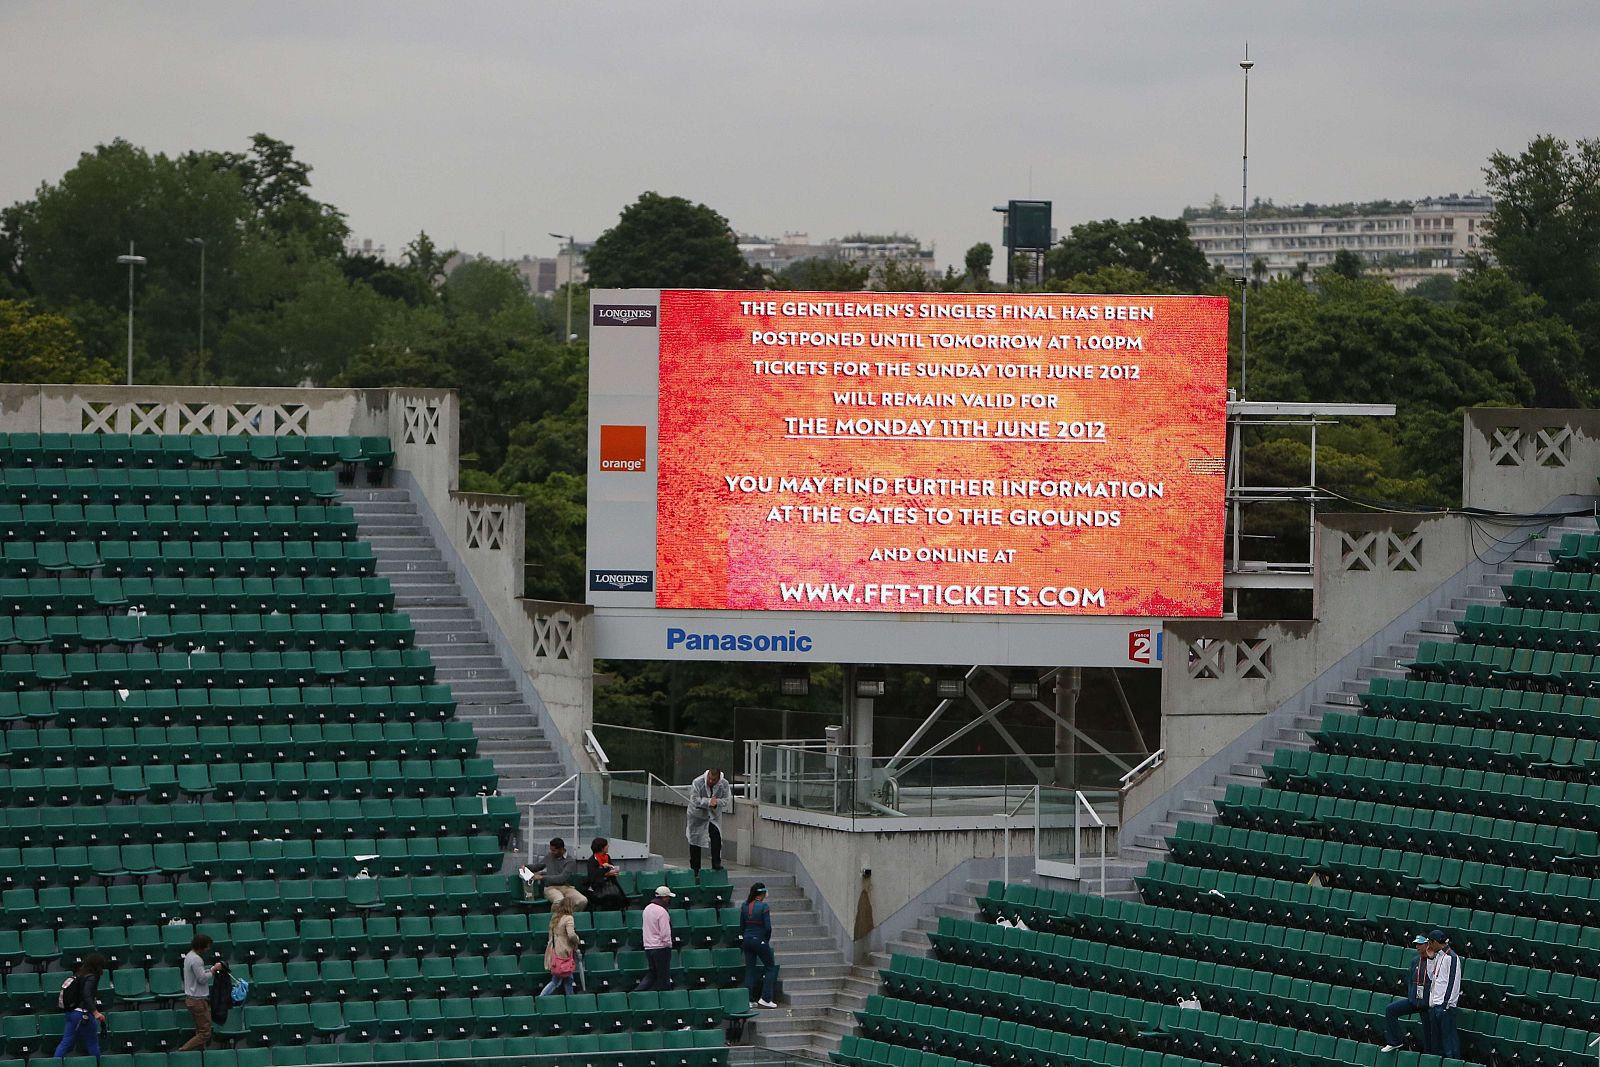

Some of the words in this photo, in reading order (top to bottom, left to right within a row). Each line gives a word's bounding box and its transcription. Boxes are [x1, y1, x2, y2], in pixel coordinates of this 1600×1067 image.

[599, 309, 652, 318] LONGINES
[740, 301, 777, 316] THE
[782, 302, 915, 318] GENTLEMEN'S
[919, 304, 996, 319] SINGLES
[1002, 305, 1056, 320] FINAL
[1061, 306, 1099, 321] HAS
[1104, 306, 1154, 321] BEEN
[752, 331, 865, 347] POSTPONED
[870, 333, 923, 348] UNTIL
[930, 333, 1042, 350] TOMORROW
[1047, 335, 1070, 349] AT
[1075, 336, 1143, 351] 1.00PM
[753, 360, 827, 375] TICKETS
[833, 362, 870, 376] FOR
[875, 362, 911, 377] THE
[916, 363, 992, 378] SUNDAY
[996, 364, 1042, 379] 10TH
[1047, 365, 1094, 379] JUNE
[1099, 365, 1140, 380] 2012
[833, 391, 876, 406] WILL
[881, 392, 956, 407] REMAIN
[961, 393, 1015, 408] VALID
[1020, 394, 1058, 408] FOR
[785, 417, 828, 434] THE
[835, 418, 935, 436] MONDAY
[941, 420, 988, 437] 11TH
[994, 421, 1050, 438] JUNE
[1056, 421, 1105, 439] 2012
[602, 460, 641, 470] orange
[725, 476, 772, 493] YOU
[778, 476, 827, 494] MAY
[833, 477, 888, 494] FIND
[894, 478, 995, 496] FURTHER
[1002, 480, 1164, 498] INFORMATION
[767, 506, 793, 522] AT
[800, 507, 842, 523] THE
[848, 507, 917, 524] GATES
[924, 508, 954, 524] TO
[959, 508, 1002, 525] THE
[1009, 509, 1121, 527] GROUNDS
[869, 547, 911, 561] AND
[916, 548, 988, 563] ONLINE
[993, 549, 1017, 563] AT
[595, 574, 648, 583] LONGINES
[780, 583, 1106, 607] WWW.FFT-TICKETS.COM
[667, 628, 813, 652] Panasonic
[1134, 637, 1151, 659] 2
